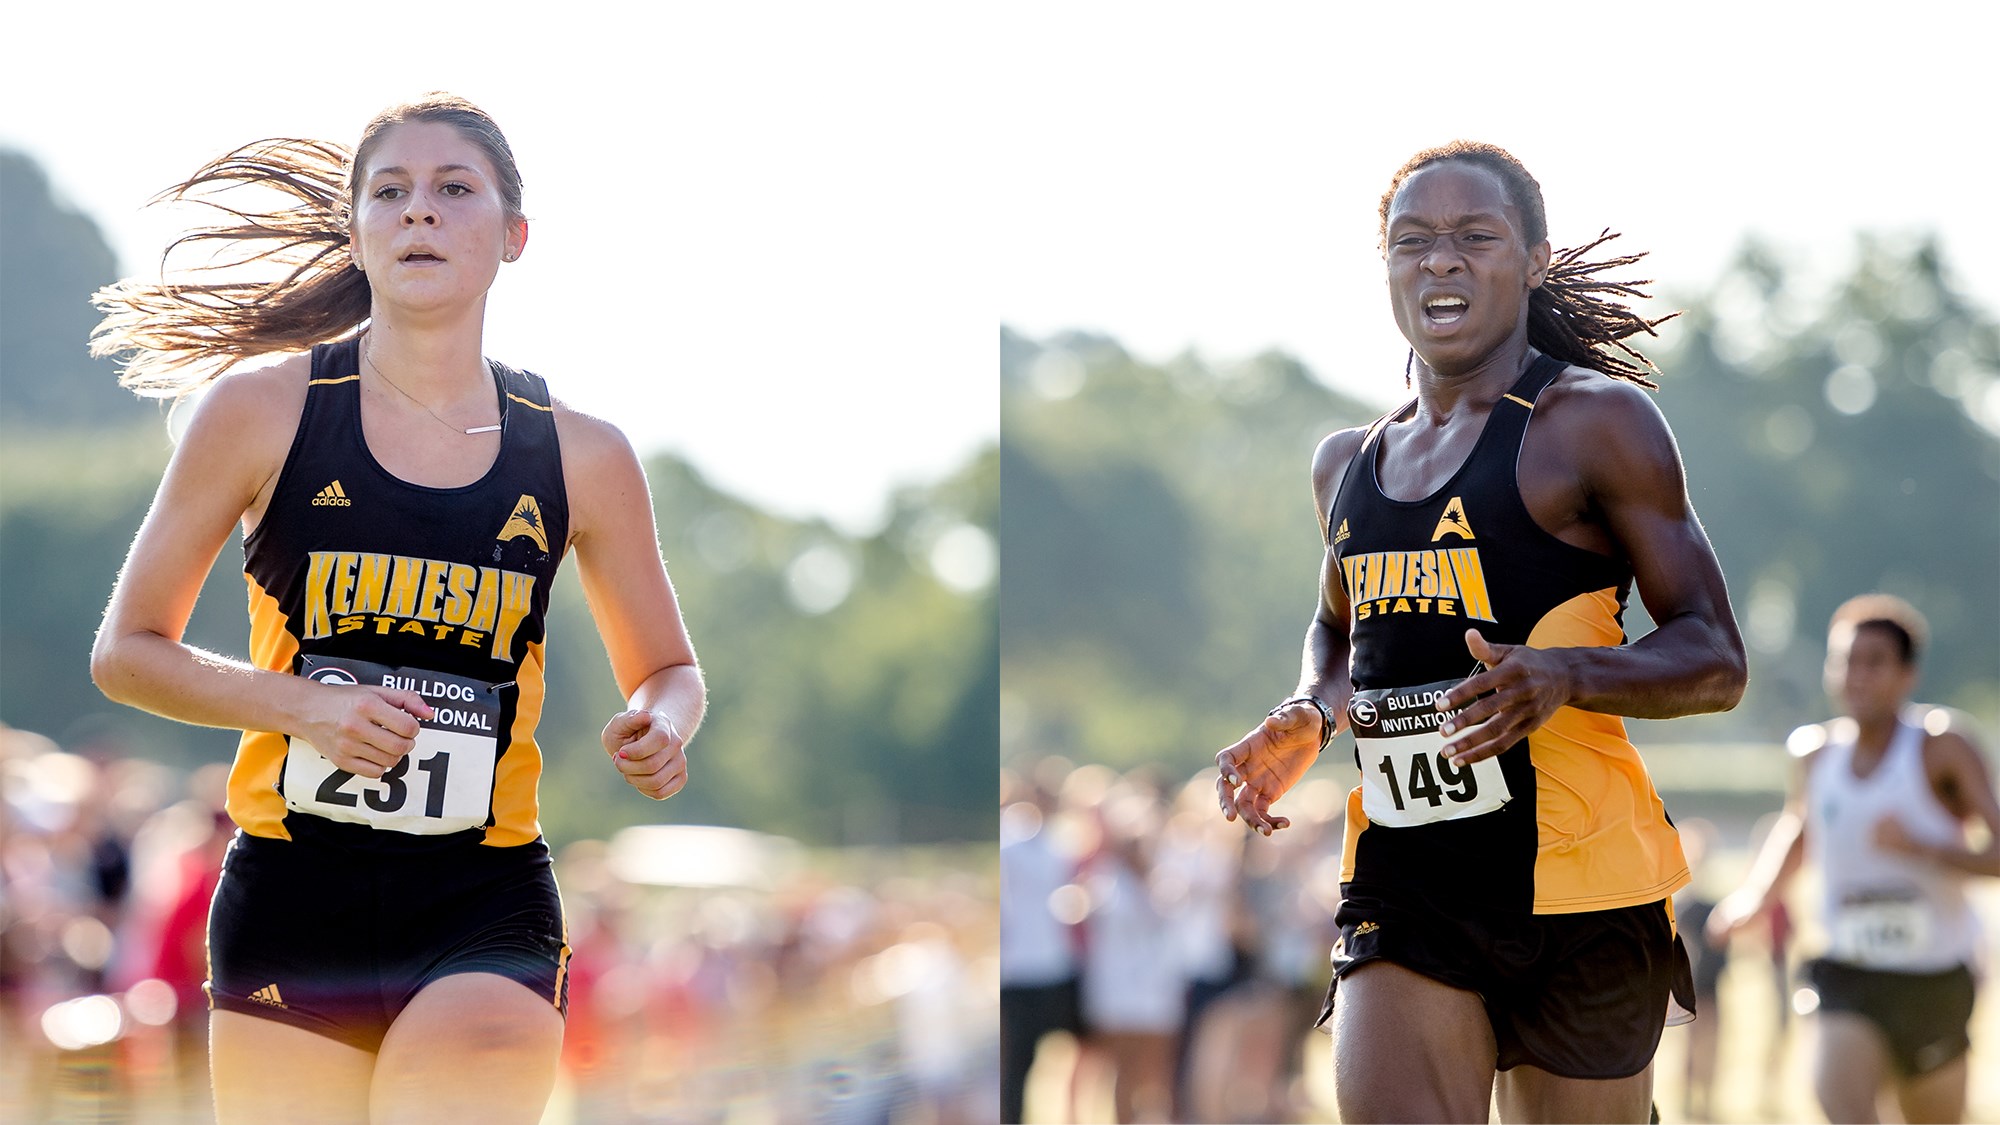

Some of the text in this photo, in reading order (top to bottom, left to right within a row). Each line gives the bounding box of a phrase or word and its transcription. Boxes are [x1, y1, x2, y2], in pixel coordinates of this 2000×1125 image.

[311, 496, 351, 507] adidas
[302, 551, 537, 664] KENNESAW
[1358, 597, 1457, 621] STATE
[336, 615, 484, 648] STATE
[1387, 689, 1454, 711] BULLDO
[1381, 708, 1469, 733] INVITATION
[1378, 752, 1478, 811] 149
